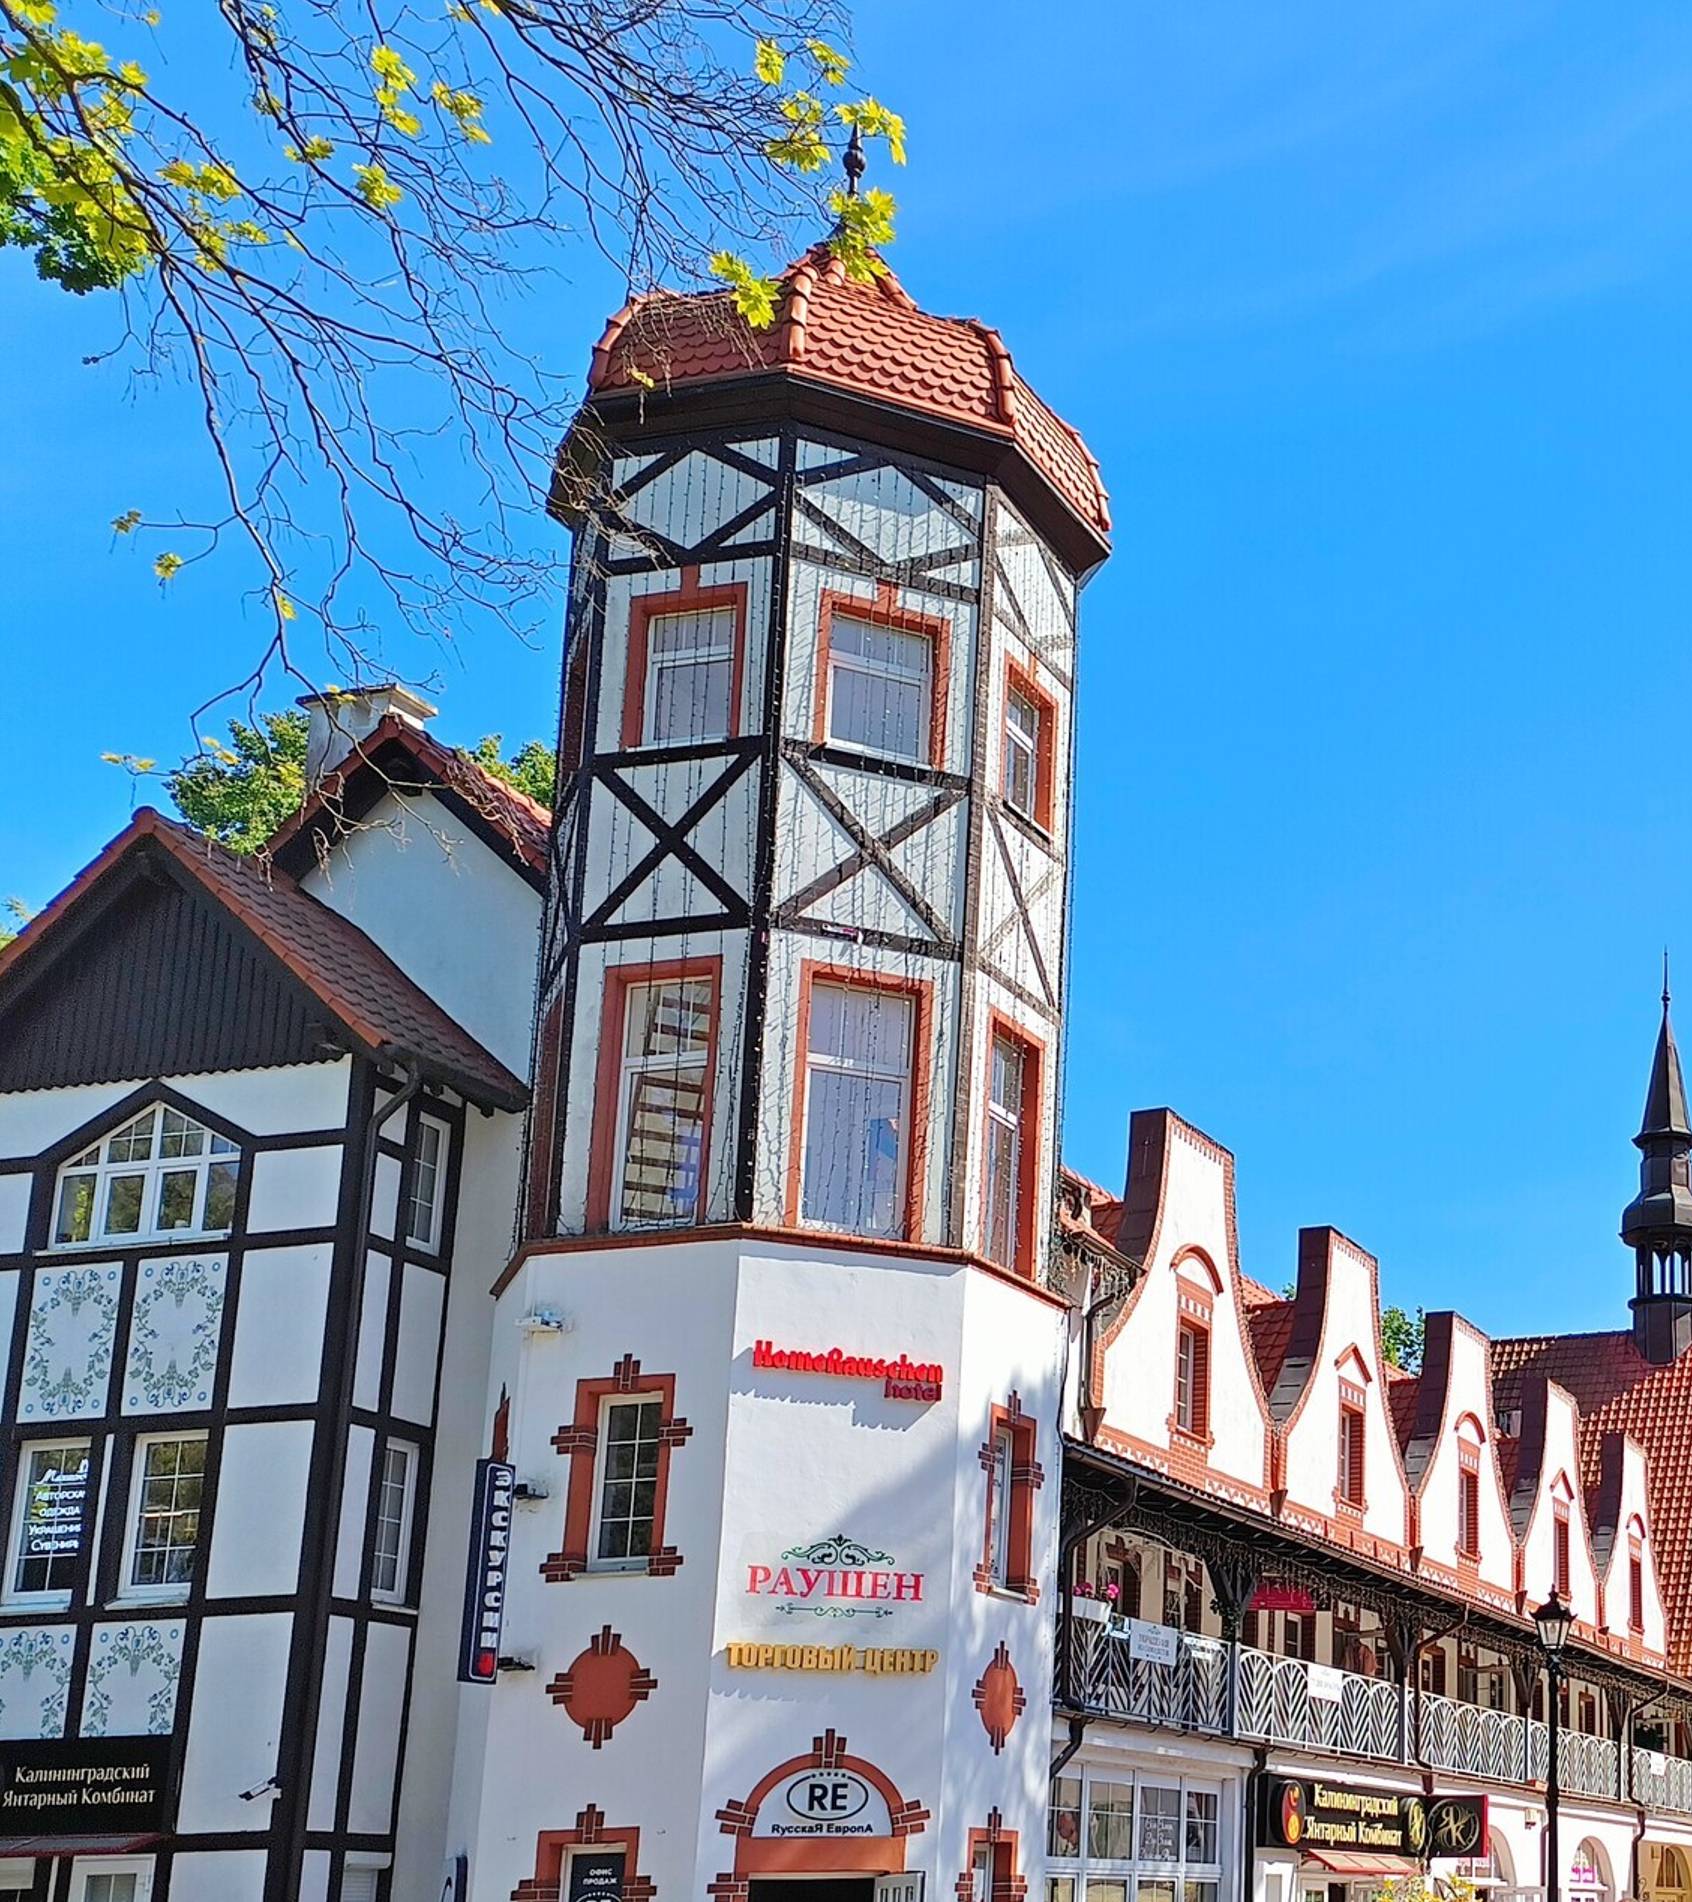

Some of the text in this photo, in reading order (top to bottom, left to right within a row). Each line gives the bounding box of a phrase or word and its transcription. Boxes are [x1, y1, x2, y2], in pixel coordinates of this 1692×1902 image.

[752, 1340, 943, 1383] HomeRauschen
[884, 1379, 942, 1402] hotel
[480, 1471, 512, 1648] ЭКСКУРСИИ
[745, 1565, 924, 1601] РАУШЕН
[727, 1642, 939, 1674] ТОРГОВЫЙ ЦЕНТР
[15, 1763, 150, 1784] Калининградский
[2, 1787, 156, 1810] Янтарный Комбинат
[808, 1783, 848, 1811] RE
[1313, 1783, 1399, 1818] Калининградский
[1305, 1815, 1356, 1846] Янтарный
[1358, 1820, 1402, 1846] Комбинат
[583, 1877, 617, 1886] ПРОДАЖ
[589, 1867, 613, 1876] ОФИС
